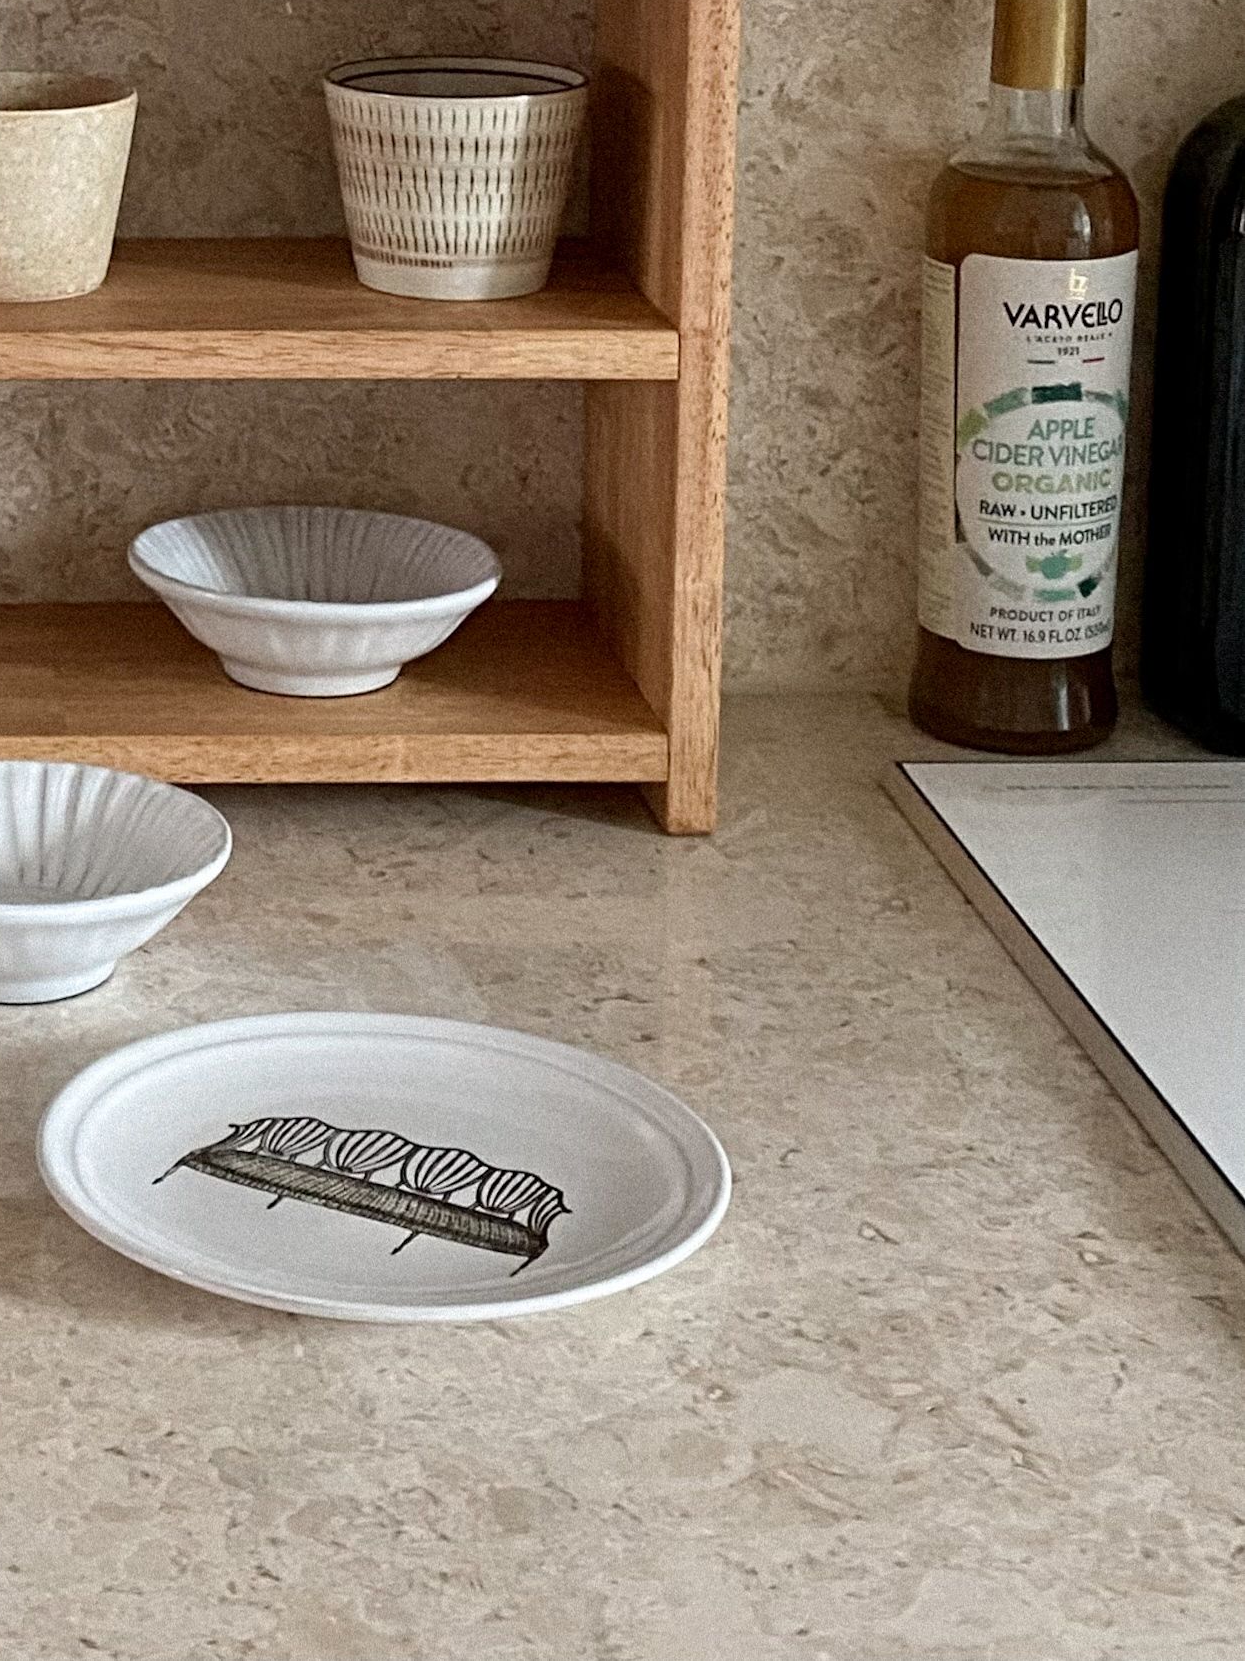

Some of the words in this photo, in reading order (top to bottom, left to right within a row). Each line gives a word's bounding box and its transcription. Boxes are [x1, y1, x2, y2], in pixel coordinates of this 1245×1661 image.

[1003, 298, 1123, 330] VARVELLO
[1027, 417, 1096, 440] APPLE
[972, 439, 1044, 467] CIDER
[992, 468, 1112, 494] ORGANIC
[980, 499, 1016, 517] RAW
[1031, 495, 1117, 521] UNFILTERED
[989, 526, 1030, 546] WITH
[1035, 533, 1055, 546] the
[990, 606, 1053, 622] PRODUCT
[1058, 609, 1073, 622] OF
[970, 622, 994, 639] NET
